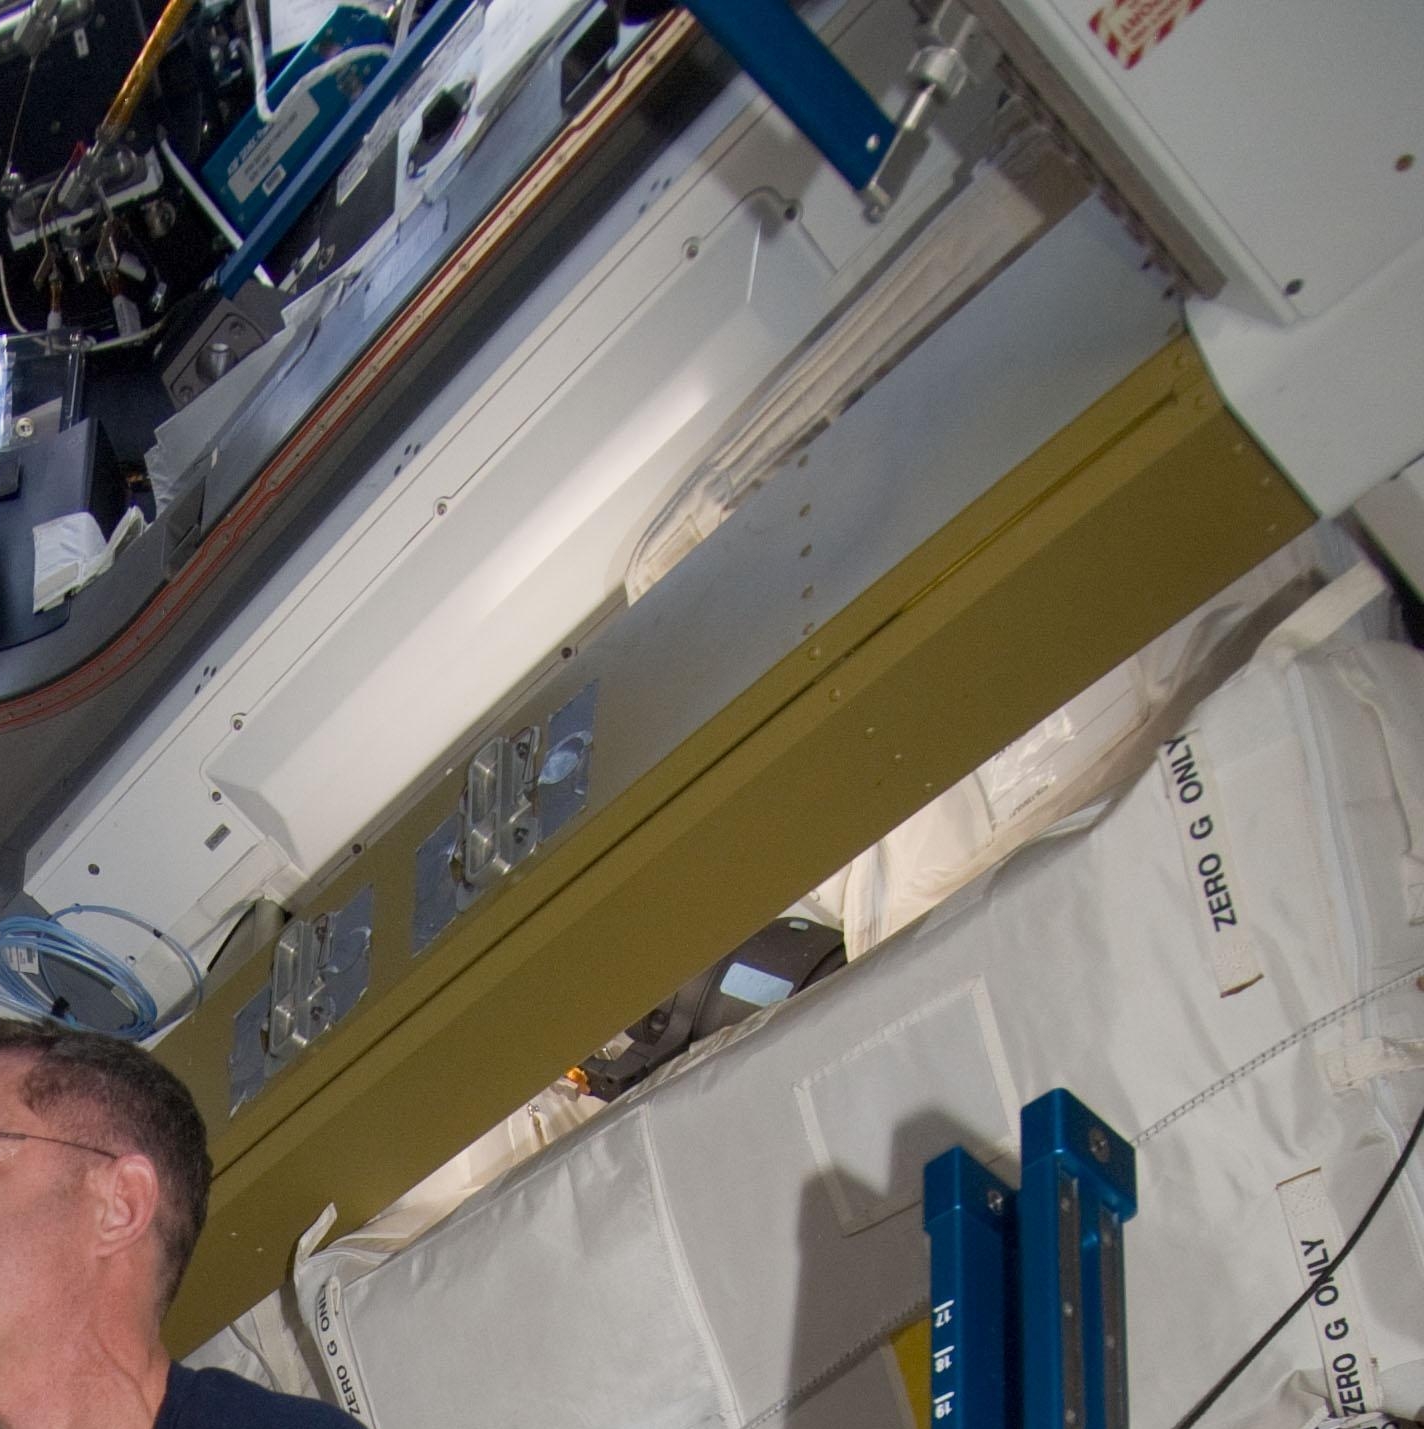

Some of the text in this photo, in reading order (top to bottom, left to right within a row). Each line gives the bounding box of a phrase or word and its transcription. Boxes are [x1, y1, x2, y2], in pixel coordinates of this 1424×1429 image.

[1163, 735, 1238, 933] ZERO G ONLY
[935, 1310, 952, 1328] 17
[1300, 1238, 1367, 1417] ZERO G ONLY
[326, 1339, 338, 1357] G
[935, 1356, 952, 1373] 18
[336, 1364, 361, 1416] ZERO
[935, 1402, 952, 1419] 19
